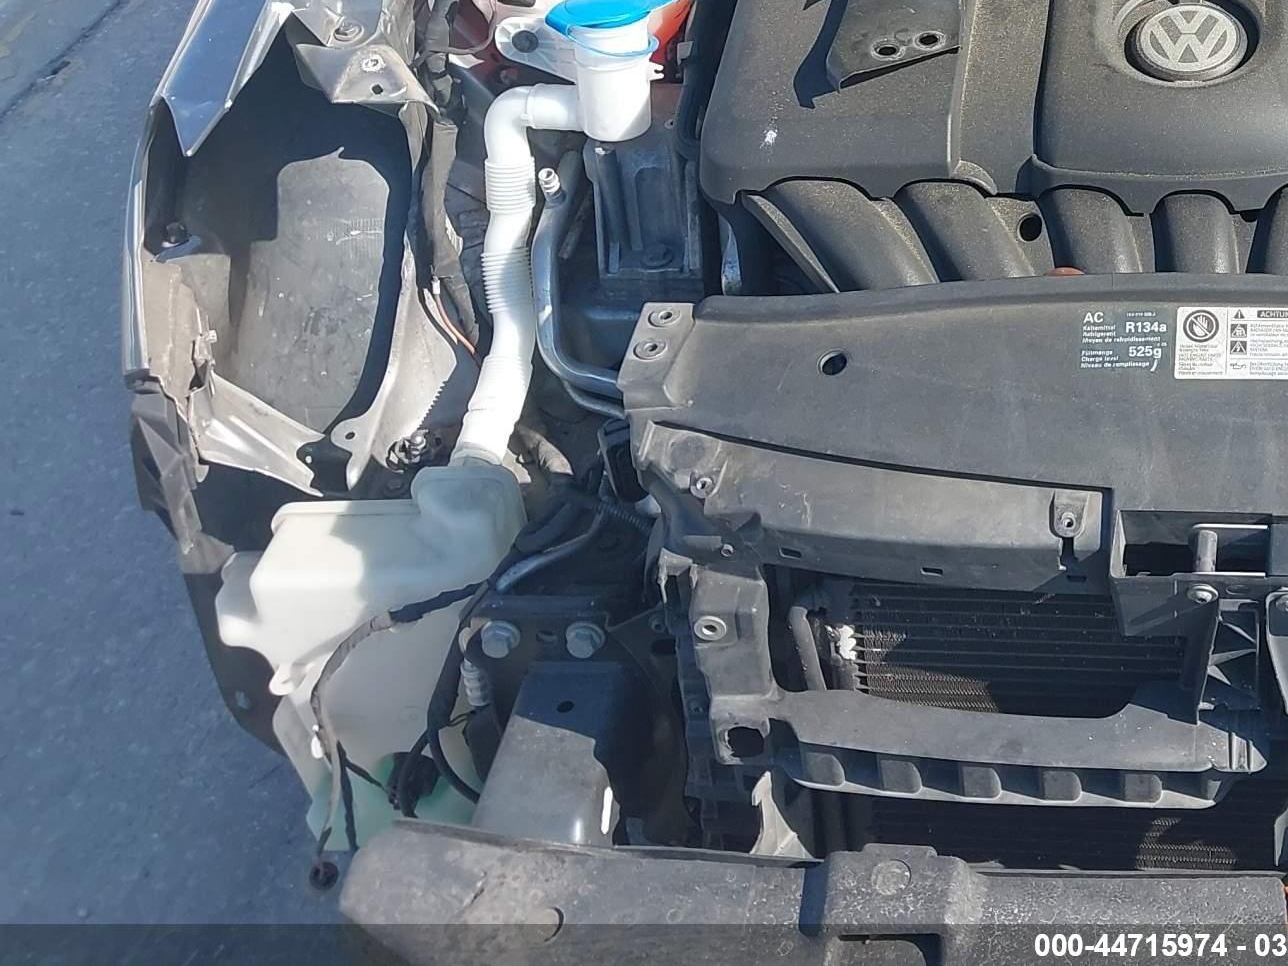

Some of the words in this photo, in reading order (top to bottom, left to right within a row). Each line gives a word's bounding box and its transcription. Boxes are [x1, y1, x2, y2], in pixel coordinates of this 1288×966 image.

[1140, 4, 1236, 70] VW
[1083, 312, 1104, 323] AC
[1125, 321, 1167, 333] R134a
[1128, 346, 1161, 358] 525g
